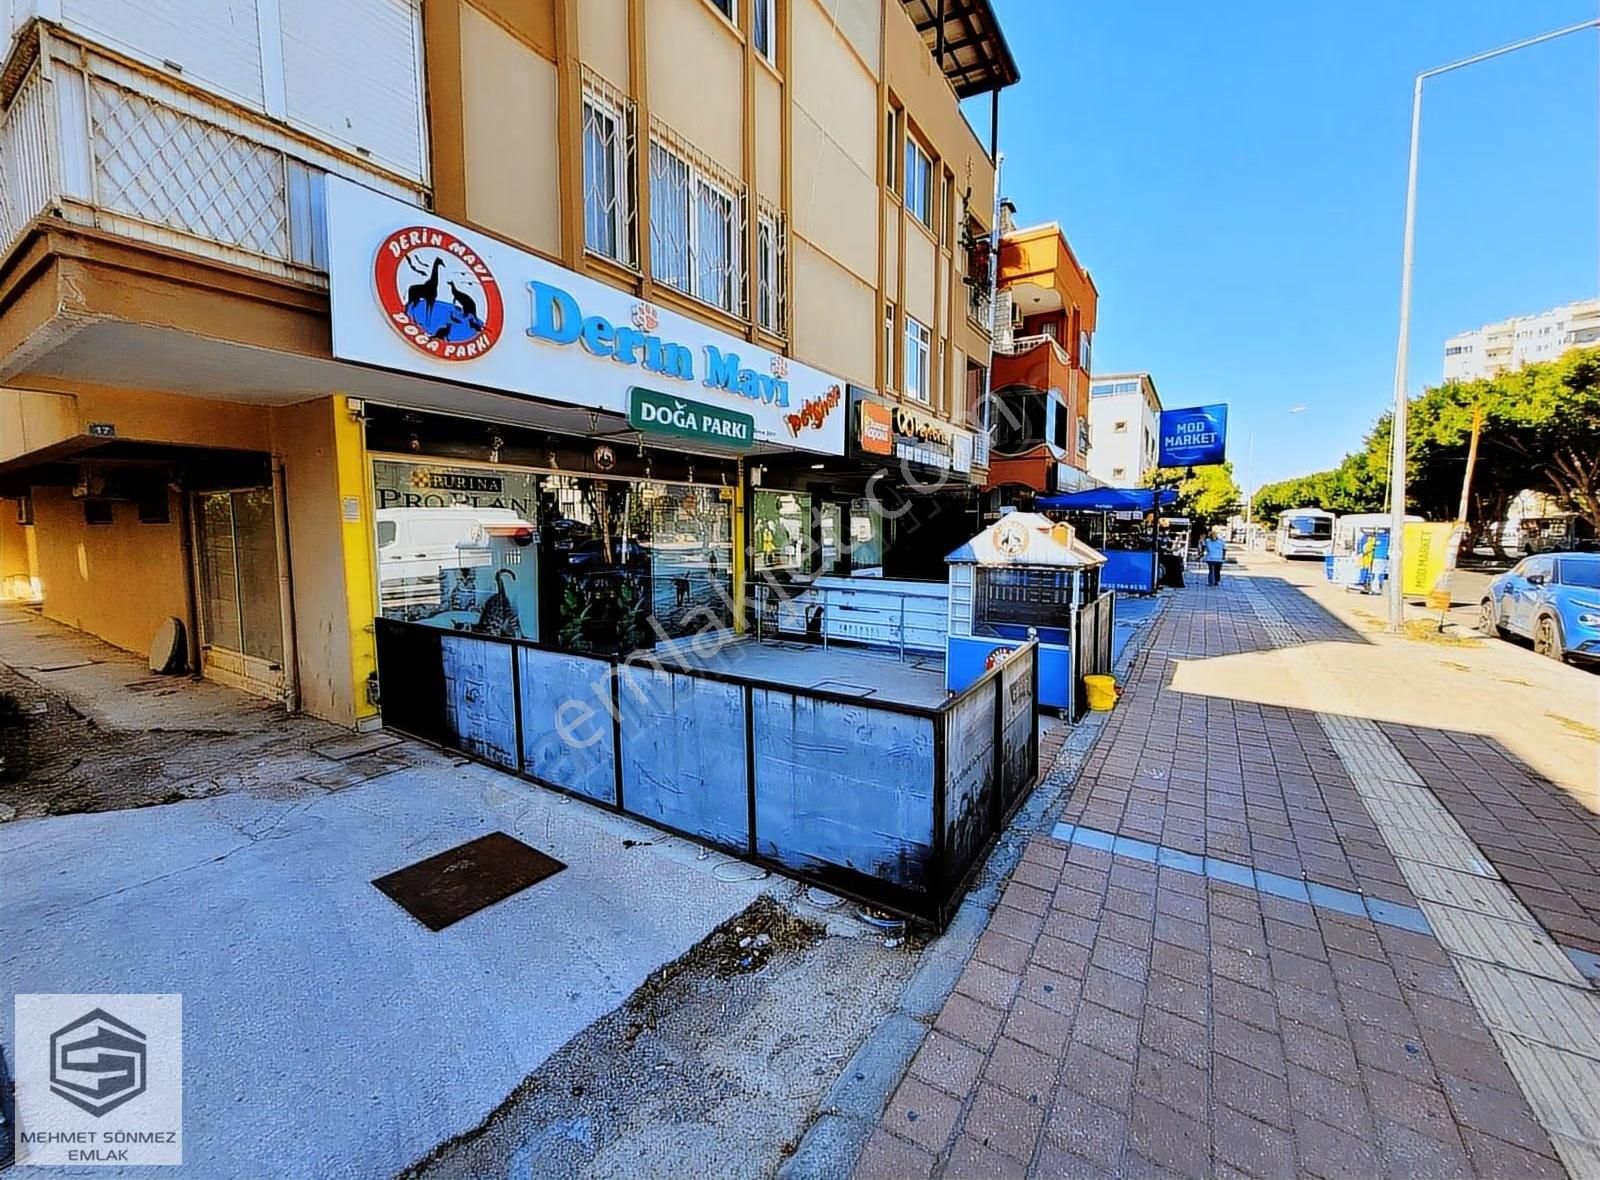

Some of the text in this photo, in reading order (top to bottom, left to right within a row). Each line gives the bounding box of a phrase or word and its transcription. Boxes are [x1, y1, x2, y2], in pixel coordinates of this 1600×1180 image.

[389, 228, 443, 257] DERİN
[393, 312, 490, 357] DOĞA PARKI
[527, 279, 790, 409] Derin Mavi
[641, 400, 747, 440] DOĞA PARKI
[1177, 421, 1205, 434] MOD
[1165, 432, 1218, 447] MARKET
[433, 475, 499, 491] PURINA
[378, 488, 444, 509] PRO
